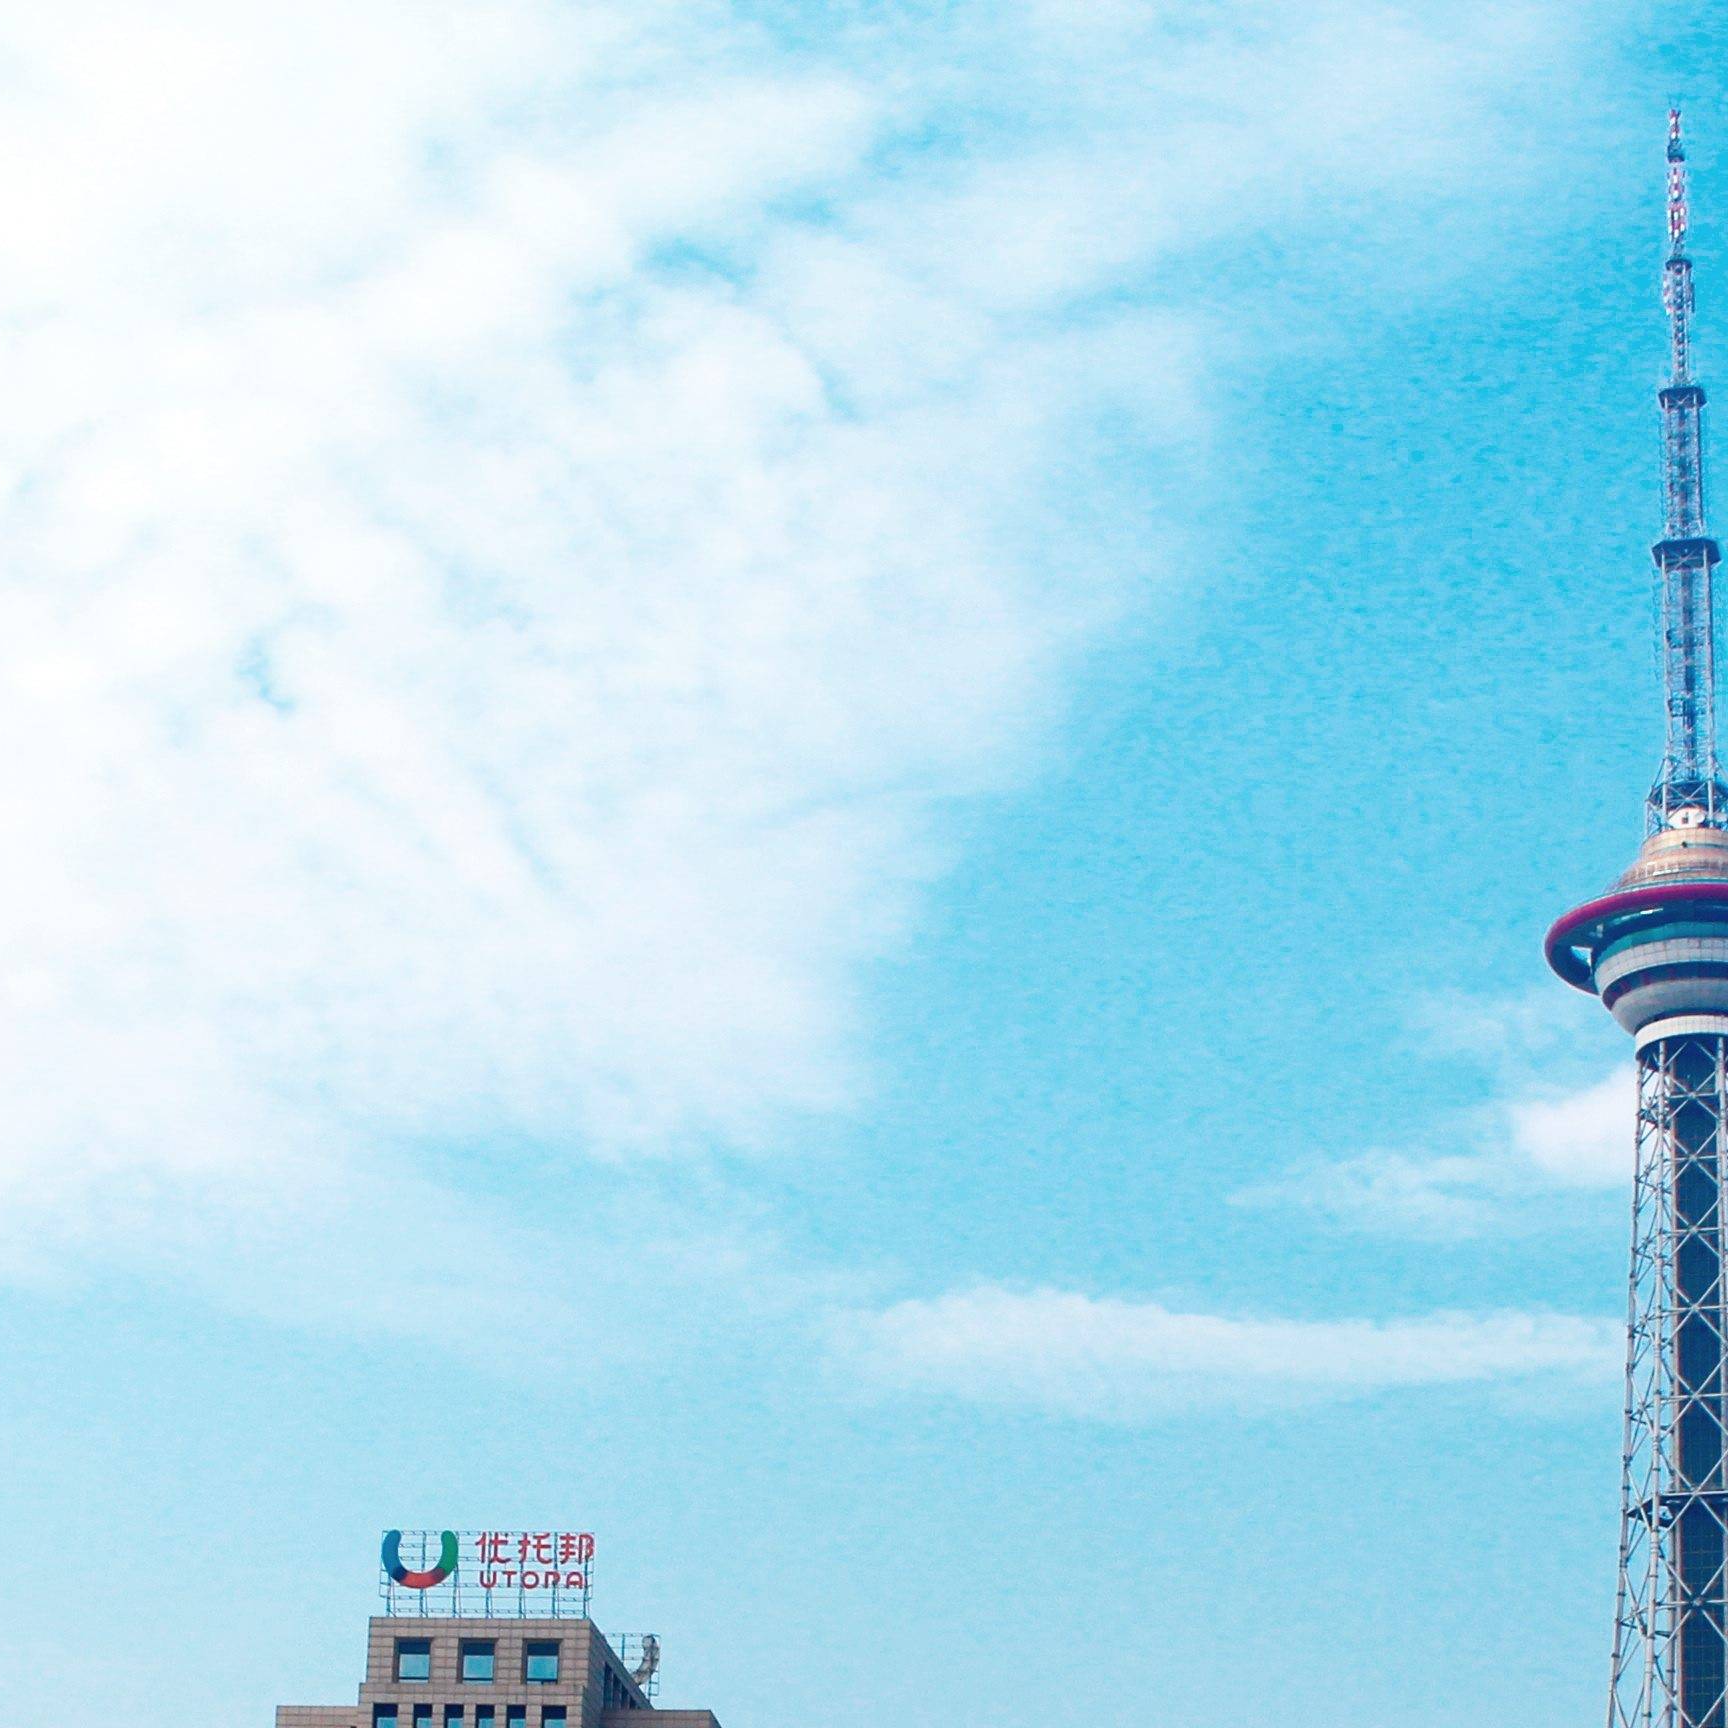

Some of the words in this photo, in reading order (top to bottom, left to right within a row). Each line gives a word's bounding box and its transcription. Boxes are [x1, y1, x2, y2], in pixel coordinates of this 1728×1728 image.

[475, 1531, 595, 1564] 优托邦
[479, 1570, 584, 1589] UTOPA
